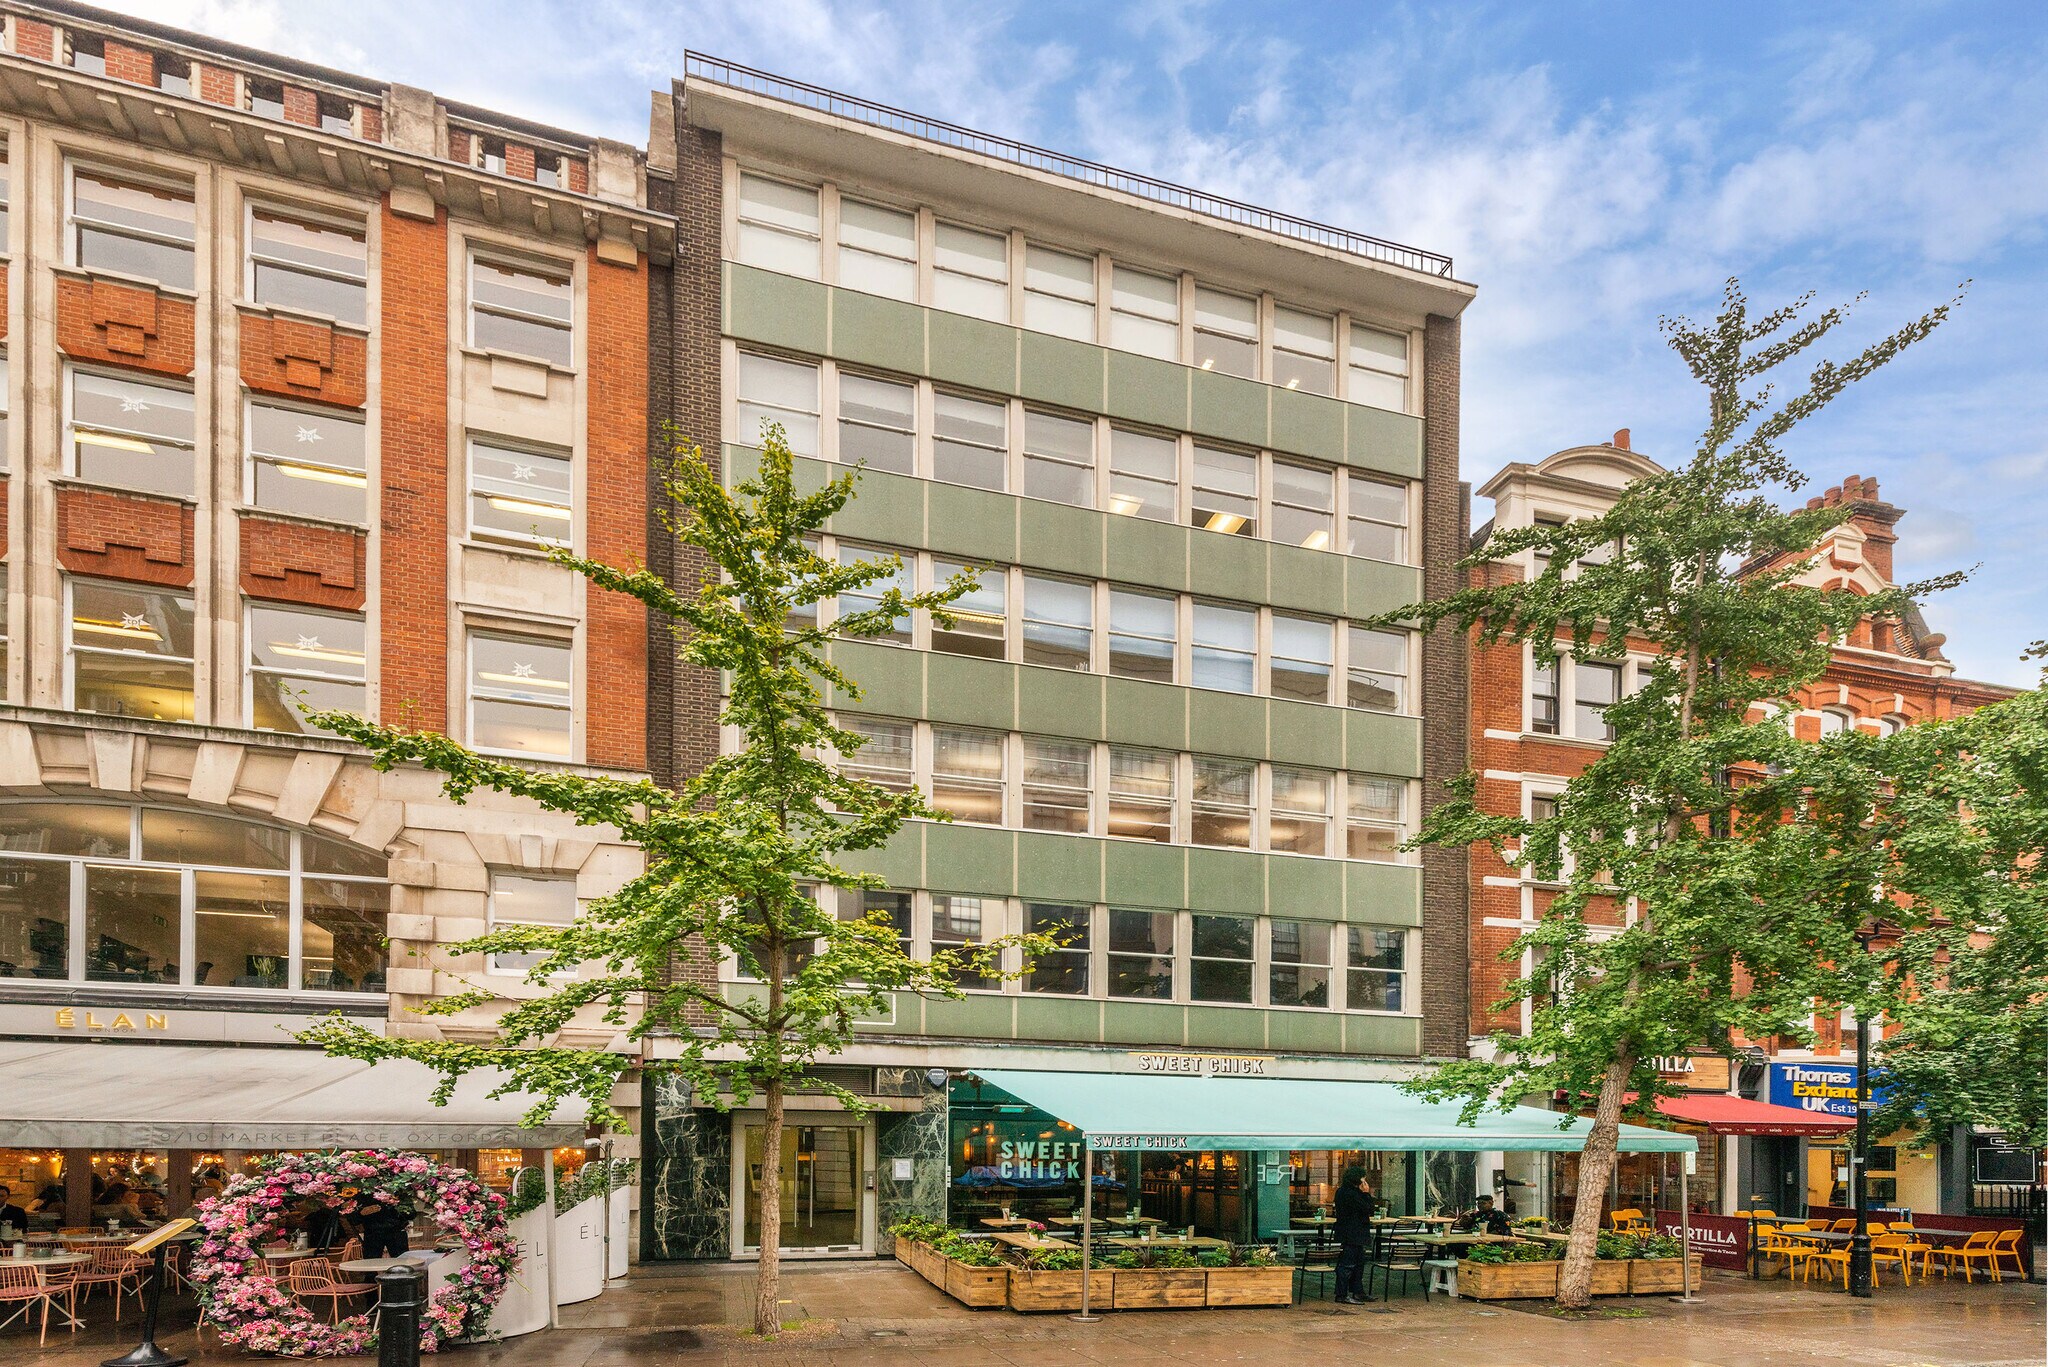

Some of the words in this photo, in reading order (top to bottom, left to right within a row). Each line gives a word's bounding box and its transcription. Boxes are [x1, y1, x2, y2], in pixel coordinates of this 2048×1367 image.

[56, 1007, 167, 1029] ÉLAN
[1138, 1055, 1202, 1072] SWEET
[1208, 1058, 1264, 1074] CHICK
[1781, 1066, 1851, 1084] Thomas
[1802, 1096, 1830, 1112] UK
[1831, 1103, 1846, 1113] Est
[1847, 1105, 1858, 1114] 19
[160, 1132, 209, 1143] 9/10
[221, 1132, 309, 1143] MARKET
[407, 1133, 492, 1143] OXFORD
[504, 1133, 574, 1143] CIRCUS
[1093, 1136, 1141, 1148] SWEET
[1145, 1136, 1188, 1148] CHICK
[1001, 1141, 1081, 1160] SWEET
[1001, 1161, 1081, 1179] CHICK
[1665, 1225, 1738, 1245] TORTILLA
